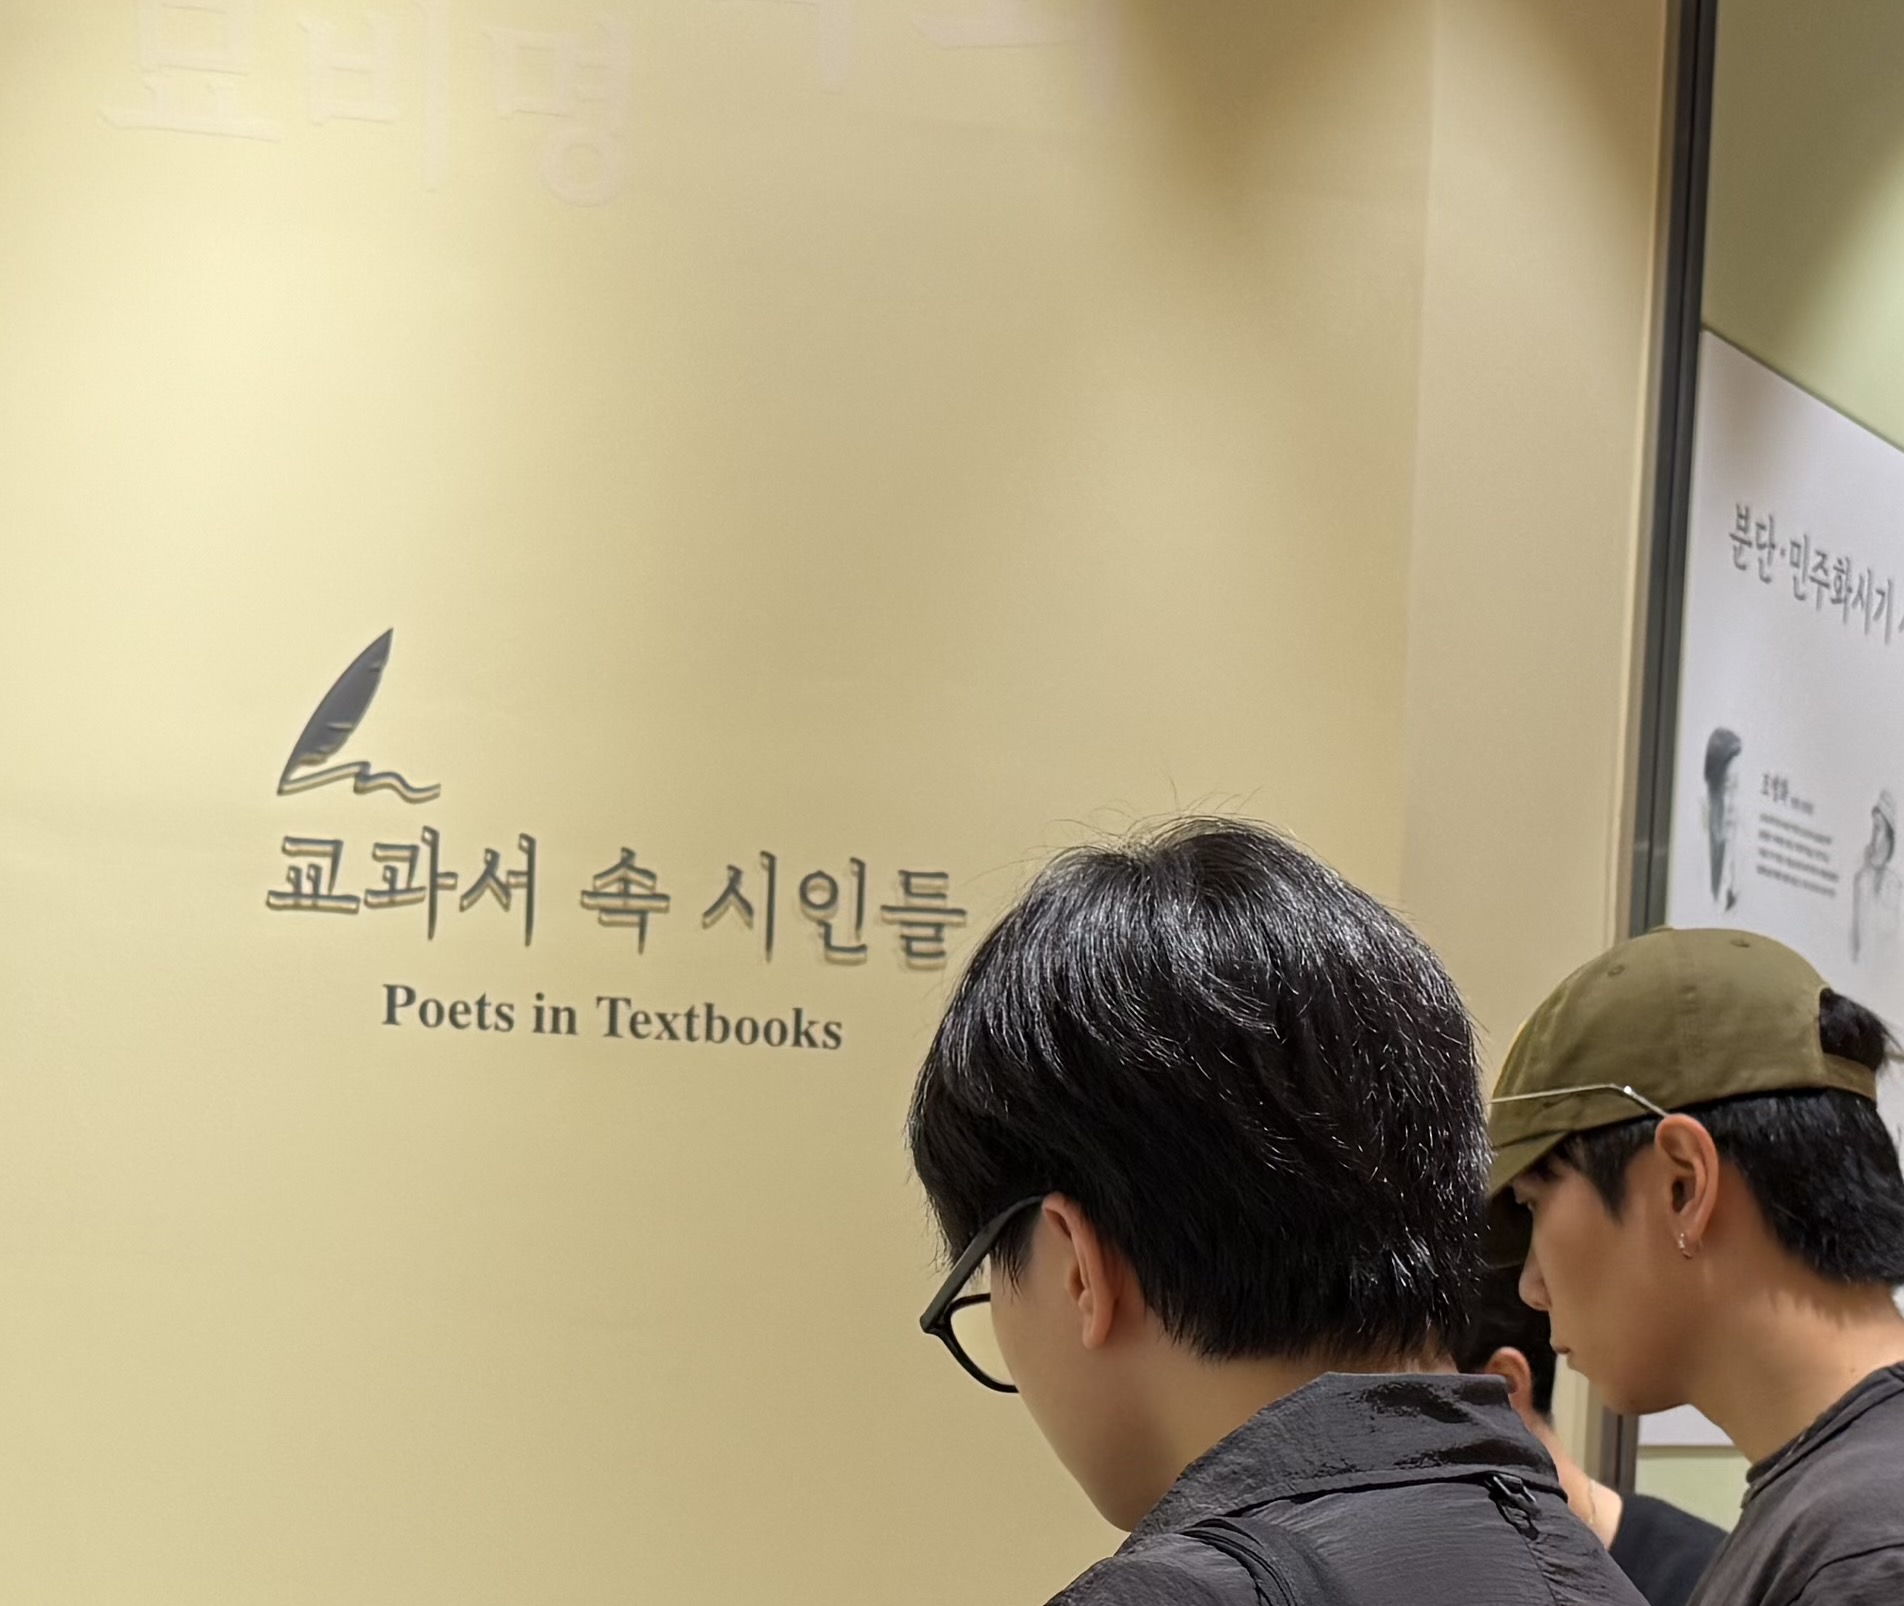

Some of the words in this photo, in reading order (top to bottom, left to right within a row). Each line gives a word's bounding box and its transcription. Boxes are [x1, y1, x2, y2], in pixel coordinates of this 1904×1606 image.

[1729, 504, 1894, 645] 분단·민주화시기
[267, 826, 536, 947] 교과서
[581, 847, 670, 953] 속
[702, 851, 968, 969] 시인들
[382, 983, 515, 1035] Poets
[533, 991, 577, 1036] in
[596, 996, 842, 1051] Textbooks
